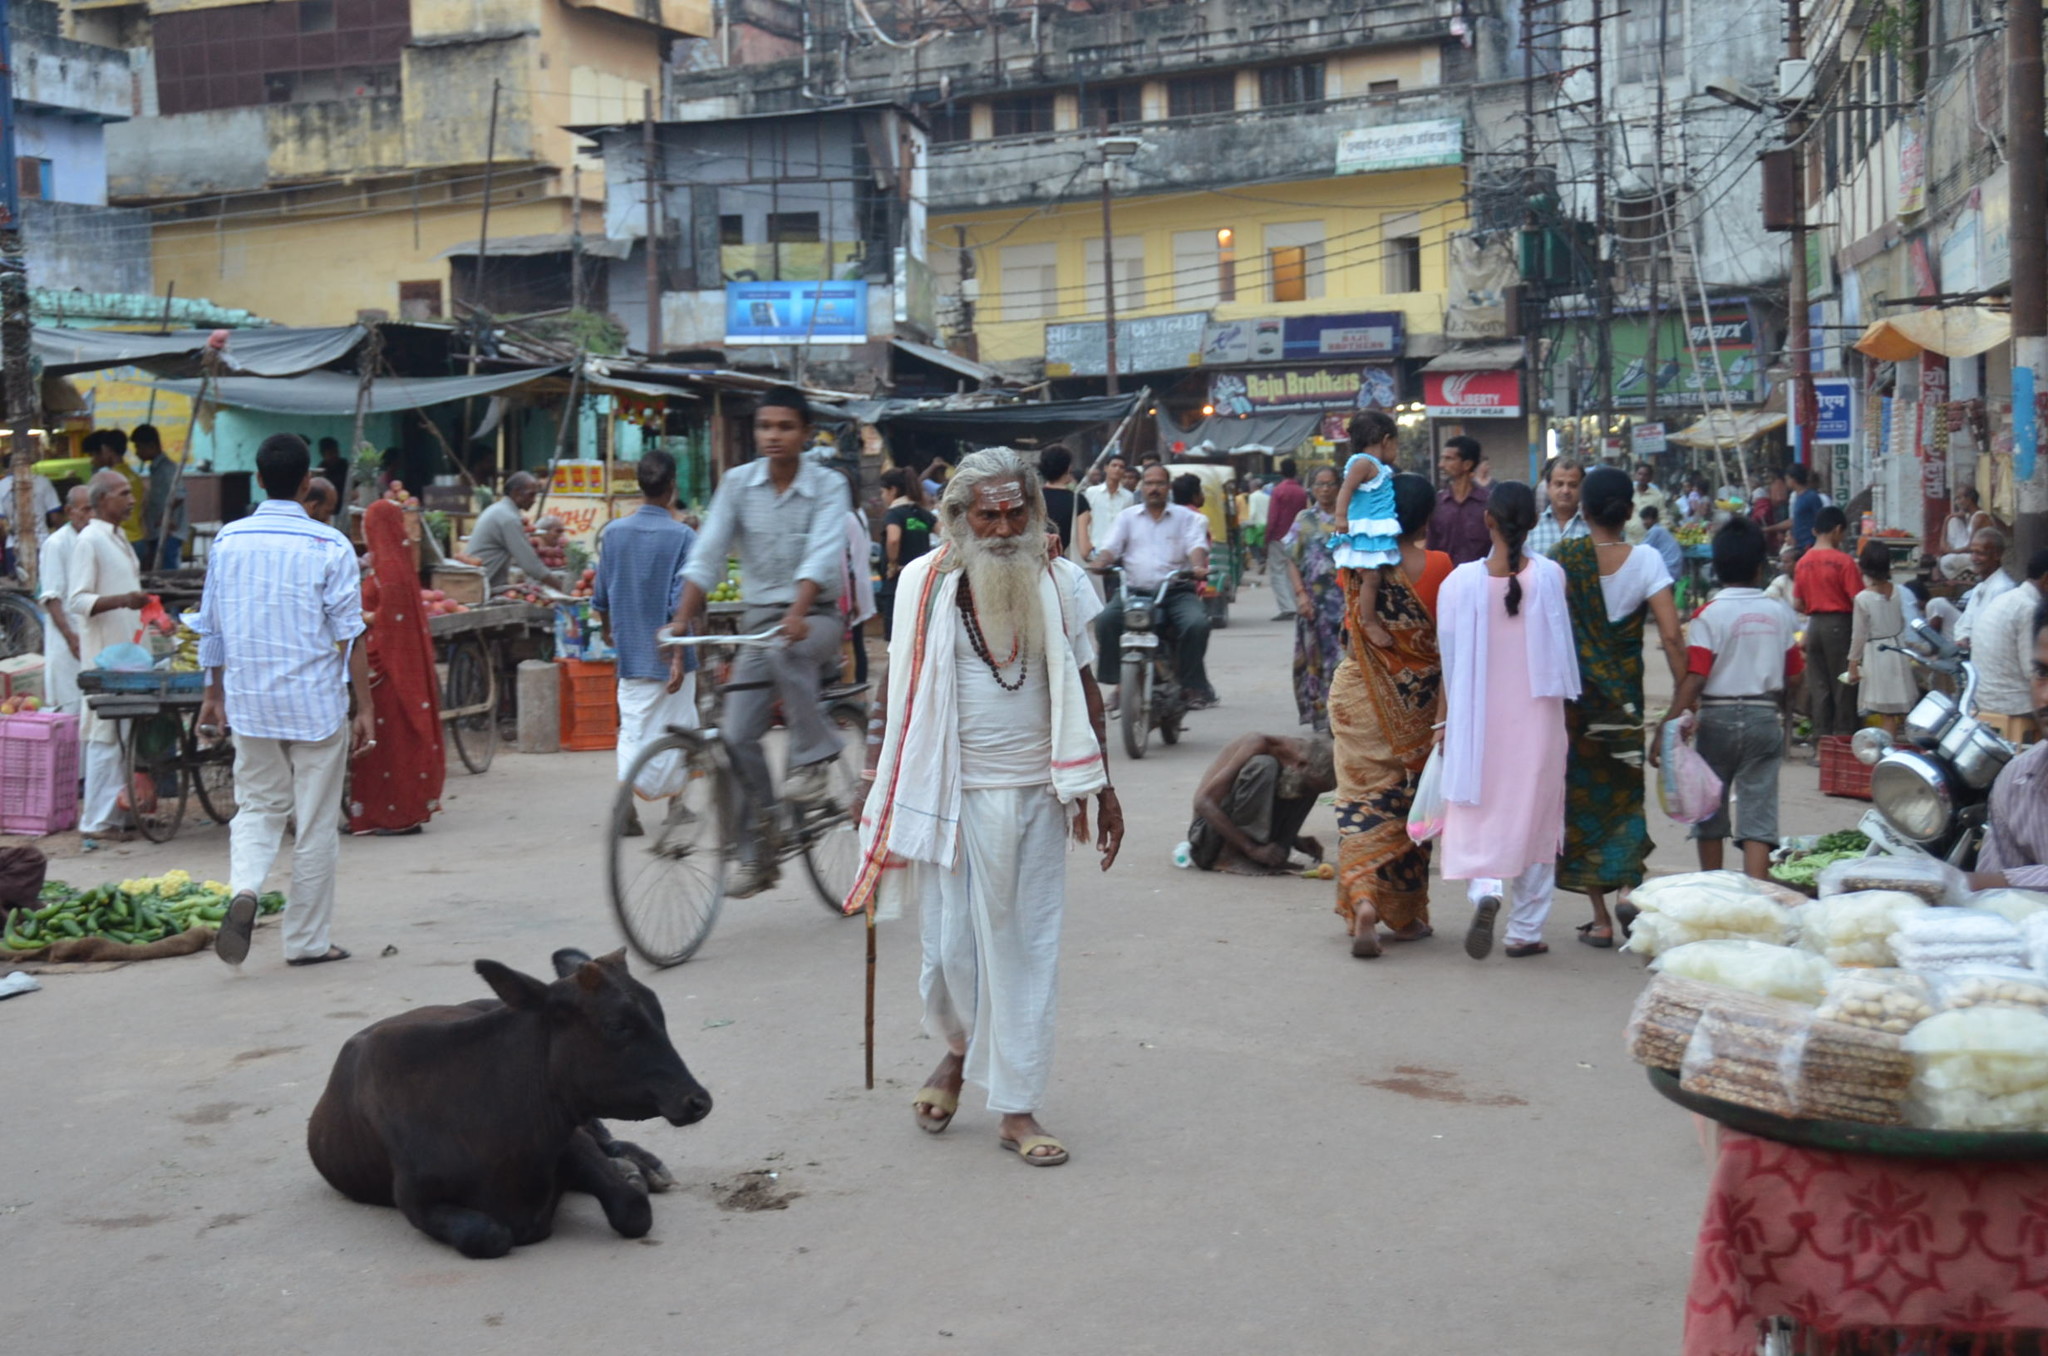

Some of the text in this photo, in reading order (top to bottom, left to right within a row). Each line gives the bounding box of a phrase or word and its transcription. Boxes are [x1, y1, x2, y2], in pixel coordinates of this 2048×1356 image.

[1246, 373, 1285, 402] Raju
[1460, 393, 1500, 405] LIBERTY
[1455, 407, 1477, 415] FOOT
